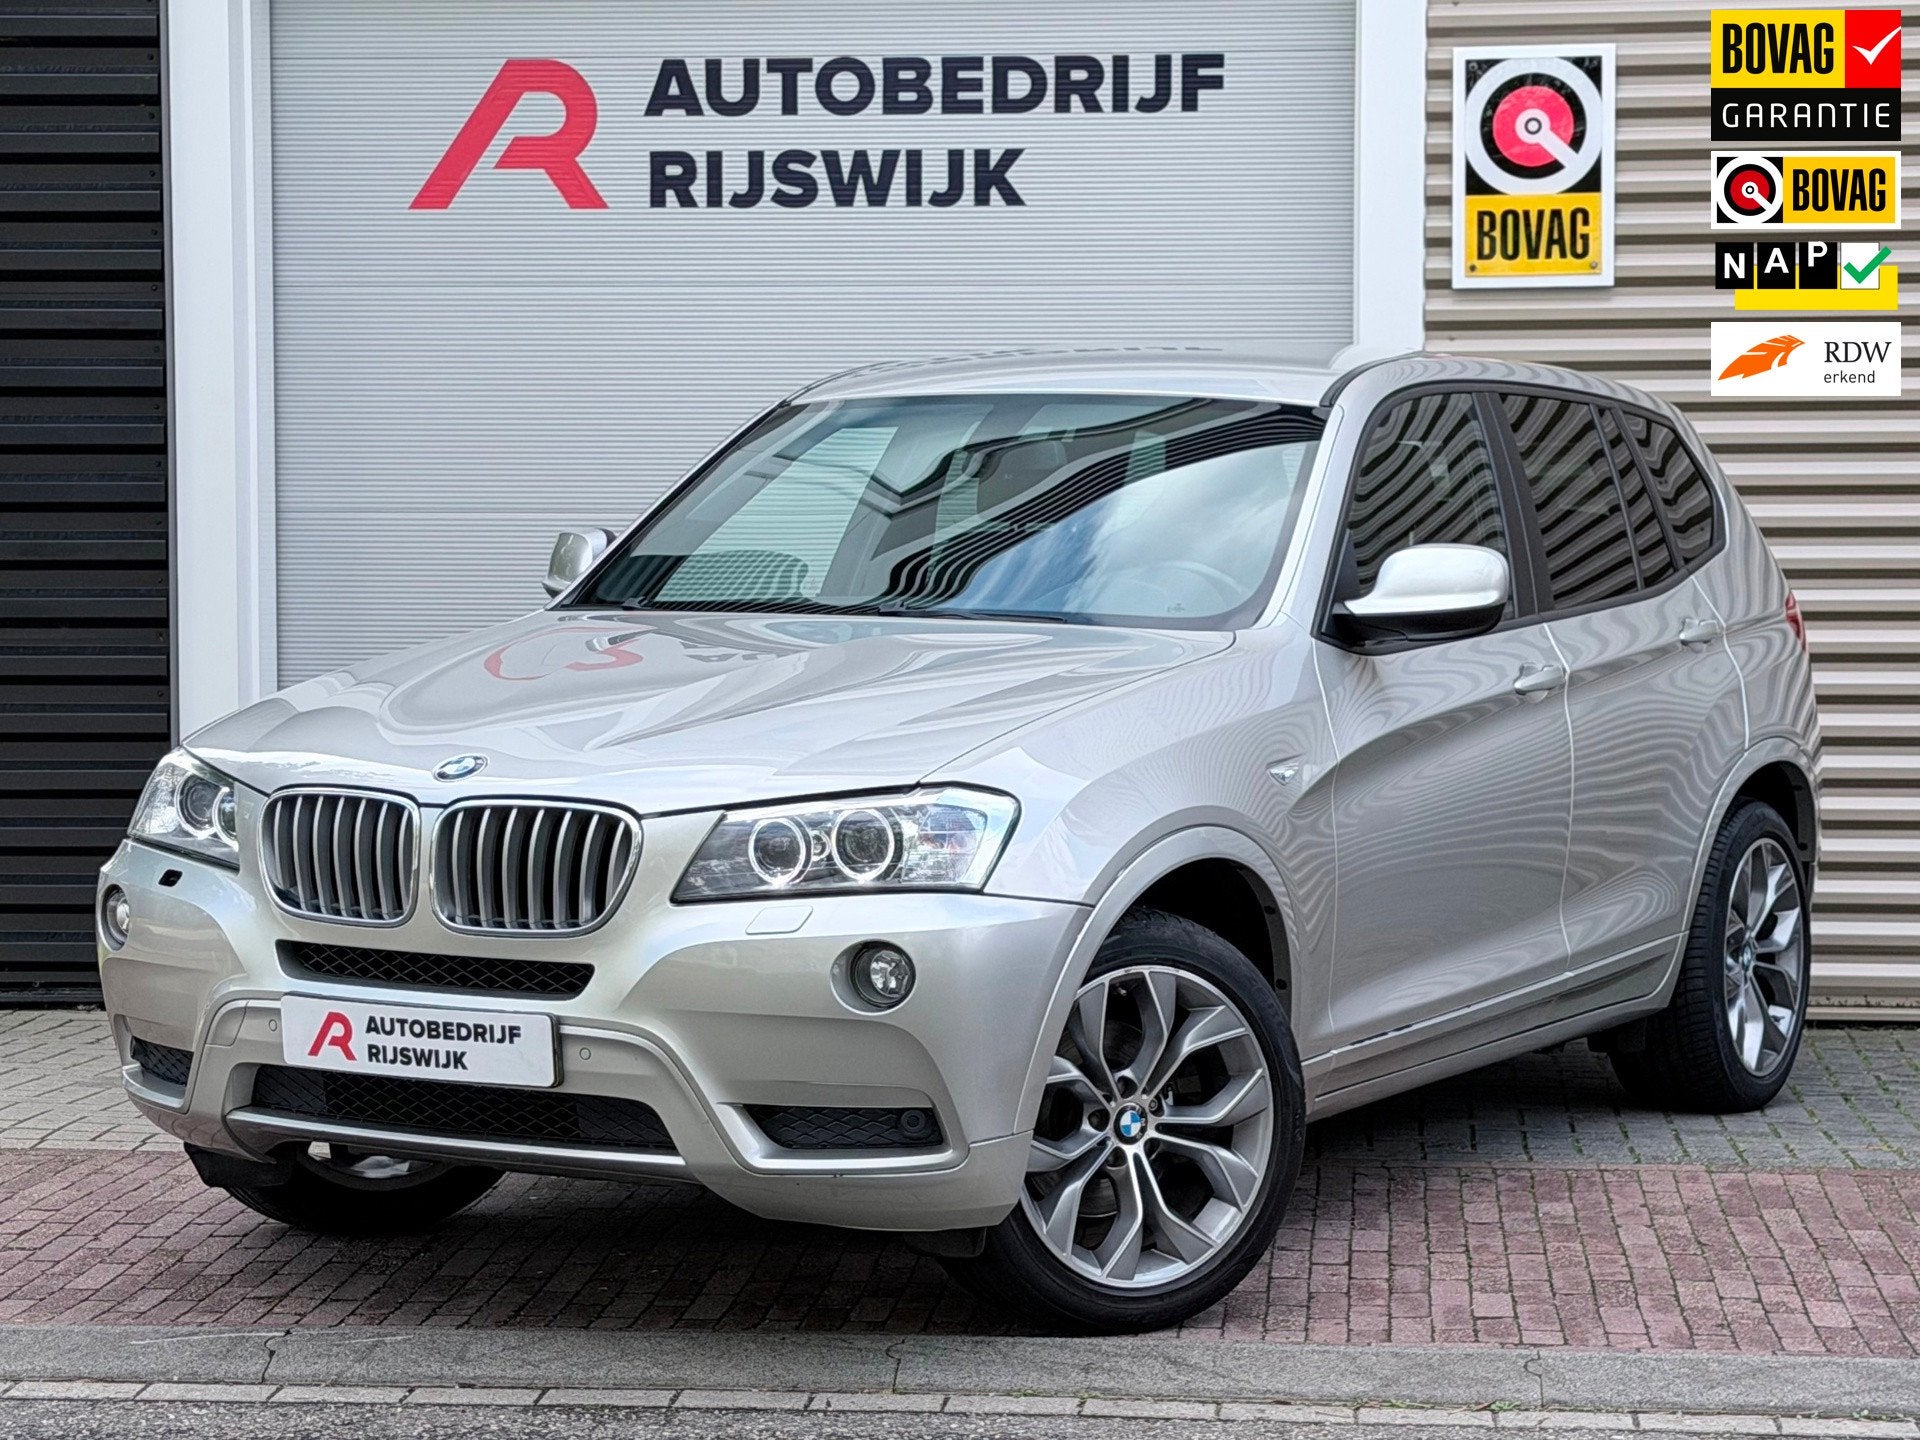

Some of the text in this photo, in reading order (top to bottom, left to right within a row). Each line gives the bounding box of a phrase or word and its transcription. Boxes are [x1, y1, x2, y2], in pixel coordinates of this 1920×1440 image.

[644, 53, 1225, 116] AUTOBEDRIJF
[649, 148, 1027, 209] RIJSWIJK
[1476, 206, 1590, 261] BOVAG
[365, 1015, 521, 1045] AUTOBEDRIJF
[367, 1044, 468, 1070] RIJSWIJK
